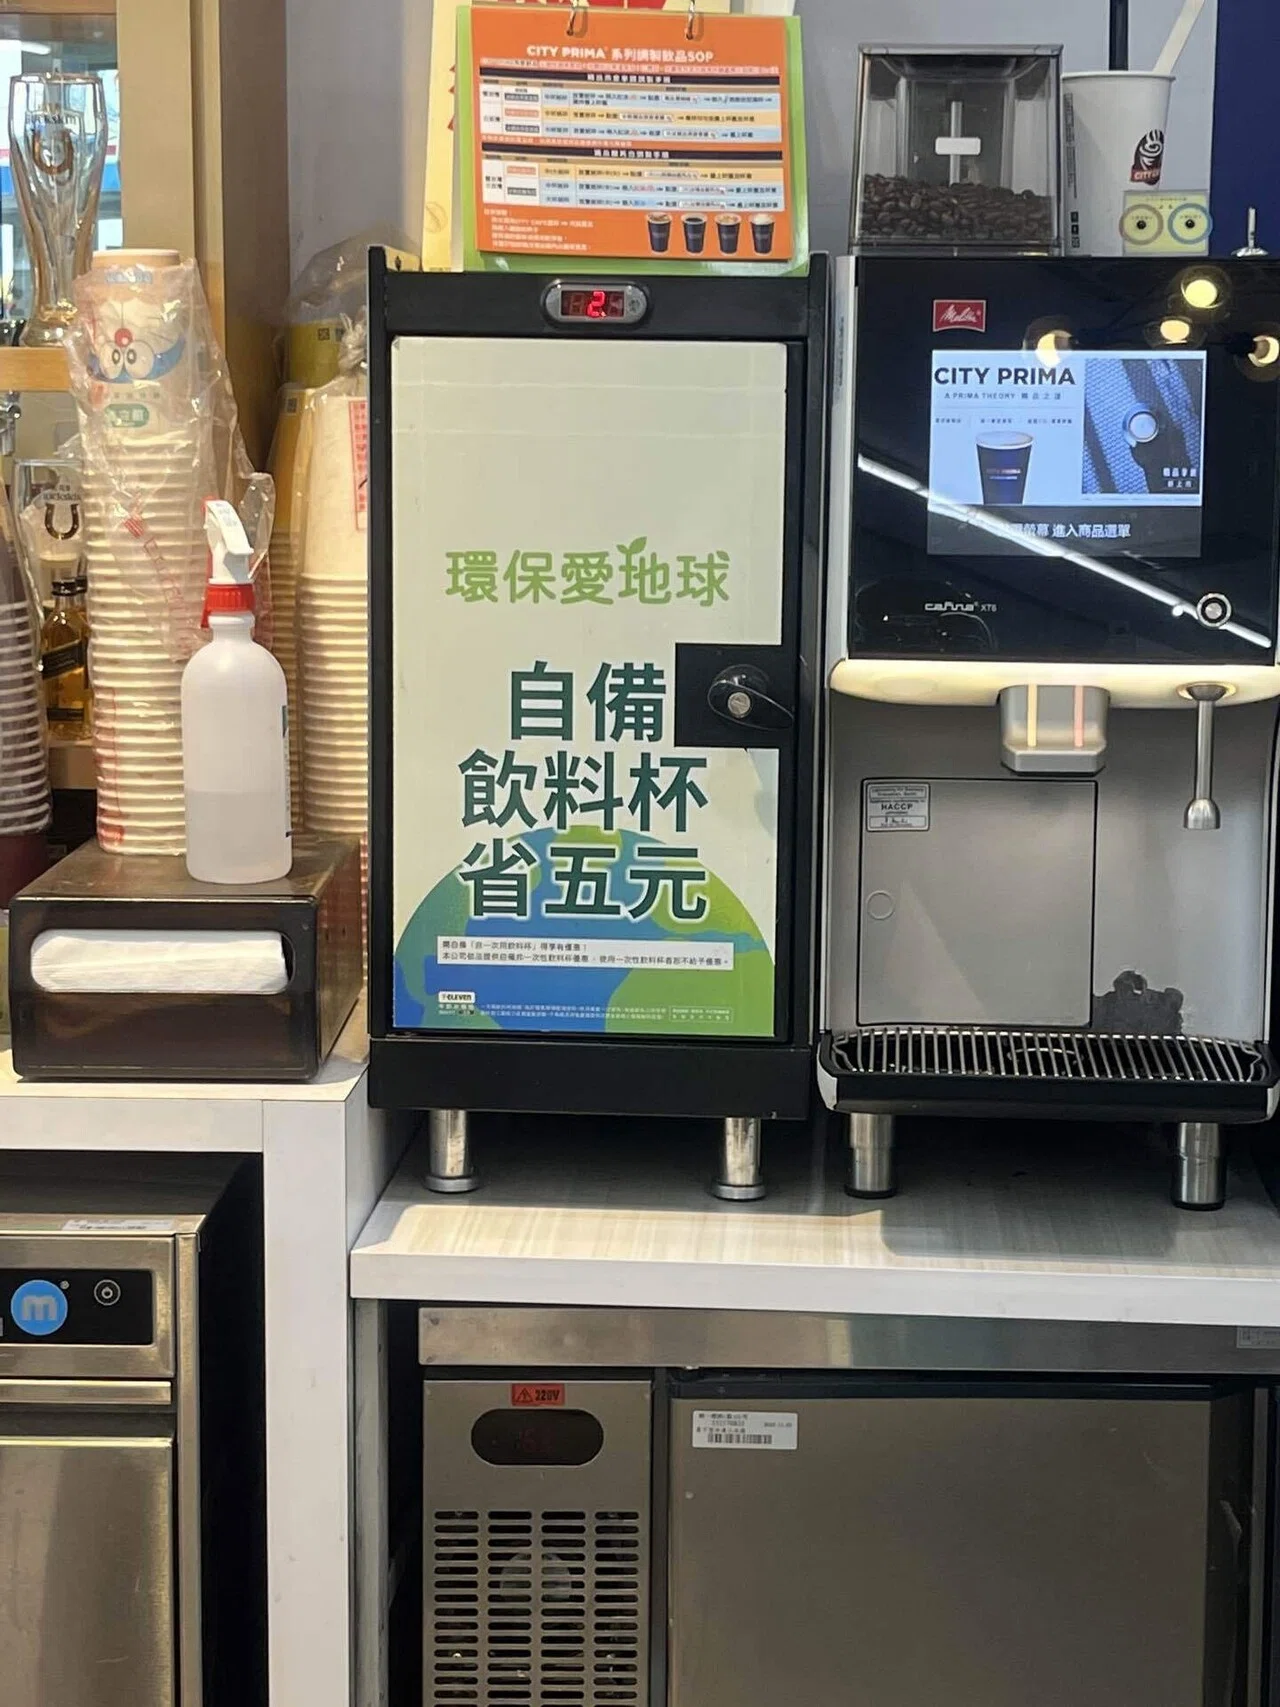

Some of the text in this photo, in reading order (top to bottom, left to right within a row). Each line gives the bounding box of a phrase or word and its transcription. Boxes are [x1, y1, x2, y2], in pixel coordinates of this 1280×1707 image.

[526, 46, 559, 57] CITY
[562, 47, 606, 59] PRIMA
[934, 367, 1076, 385] CITY PRIMA
[1052, 523, 1131, 538] 進入商品選單
[445, 540, 730, 607] 環保愛地球
[510, 660, 666, 742] 自備
[458, 749, 709, 833] 飲料杯
[881, 803, 913, 811] HACCP
[458, 838, 708, 921] 省五元
[535, 1389, 561, 1401] 220V
